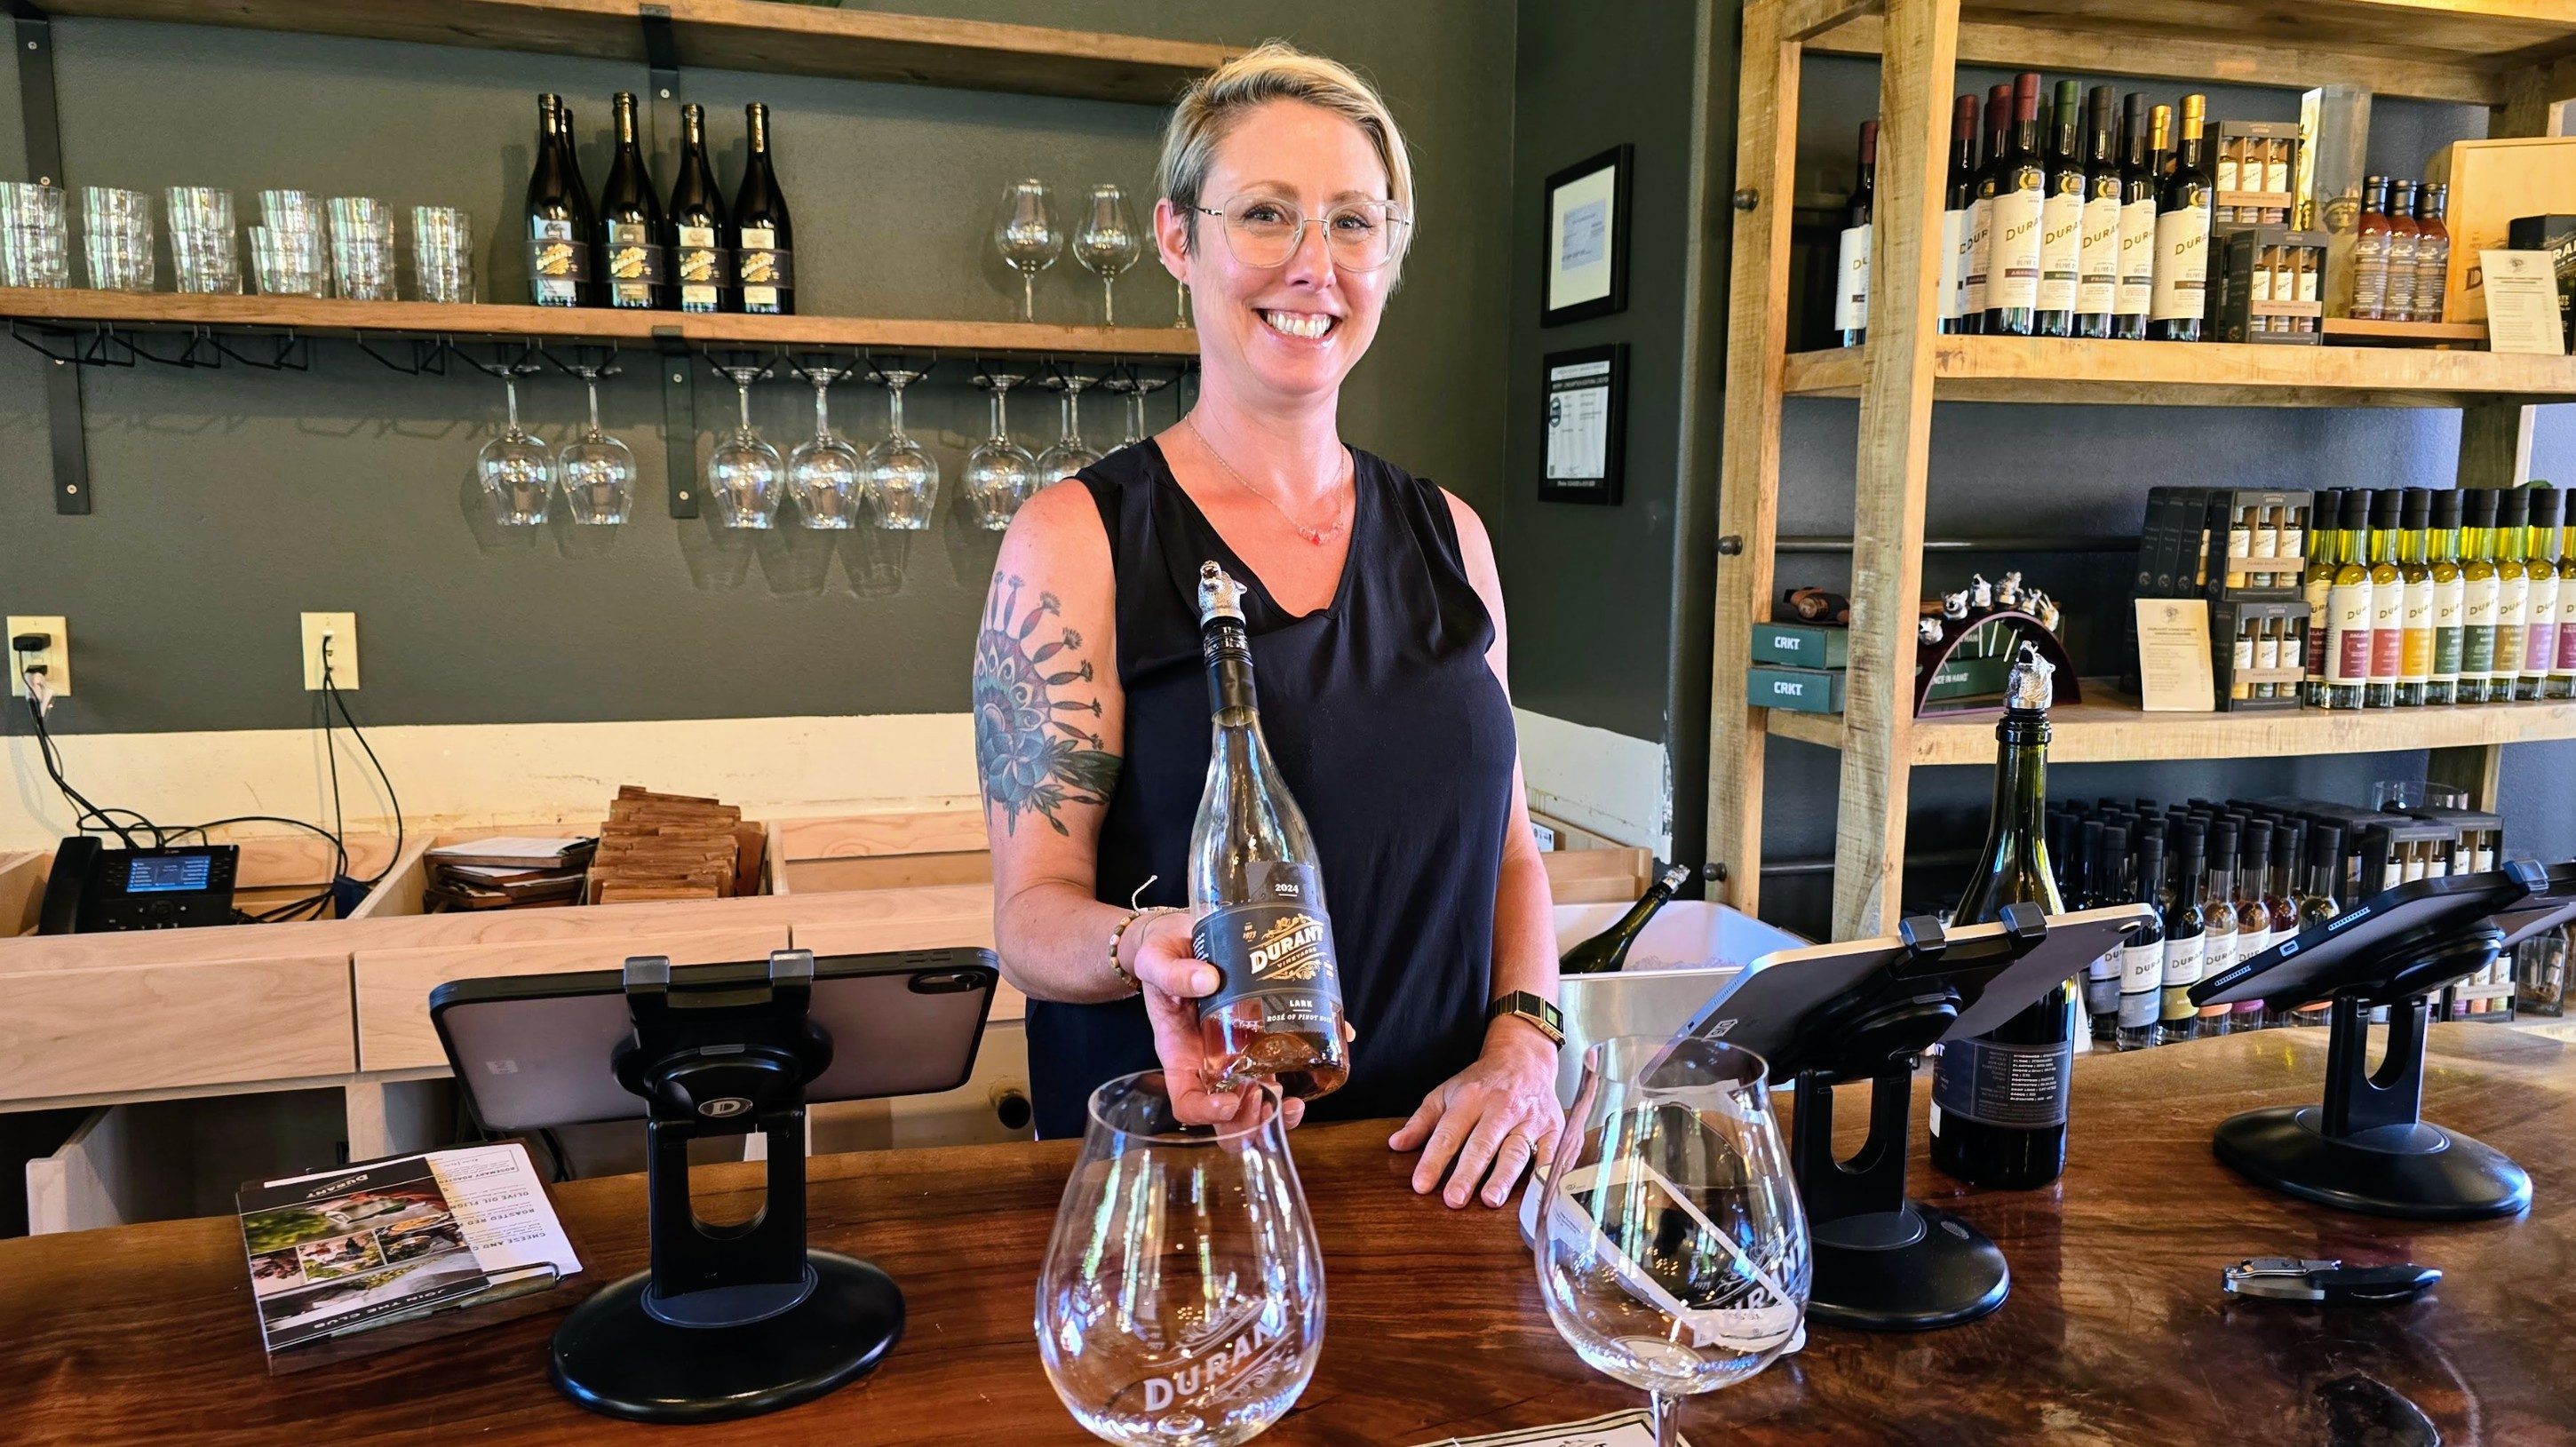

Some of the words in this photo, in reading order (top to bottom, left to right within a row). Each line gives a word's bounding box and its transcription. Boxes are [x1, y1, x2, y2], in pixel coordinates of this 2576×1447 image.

[1774, 636, 1801, 650] CRKT
[1774, 681, 1803, 696] CRKT
[1275, 883, 1299, 894] 2024
[1250, 925, 1324, 974] DURANT
[1276, 947, 1317, 968] VINEYARDS
[1289, 999, 1313, 1008] LARK
[1267, 1013, 1286, 1022] ROSÉ
[474, 1166, 515, 1179] ROSEMARY
[306, 1173, 369, 1199] DURANT
[500, 1191, 529, 1201] OLIVE
[490, 1208, 535, 1221] ROASTED
[508, 1232, 546, 1244] CHEESE
[482, 1241, 504, 1250] AND
[406, 1288, 446, 1302] JOIN
[366, 1301, 402, 1314] THE
[314, 1312, 361, 1329] CLUB
